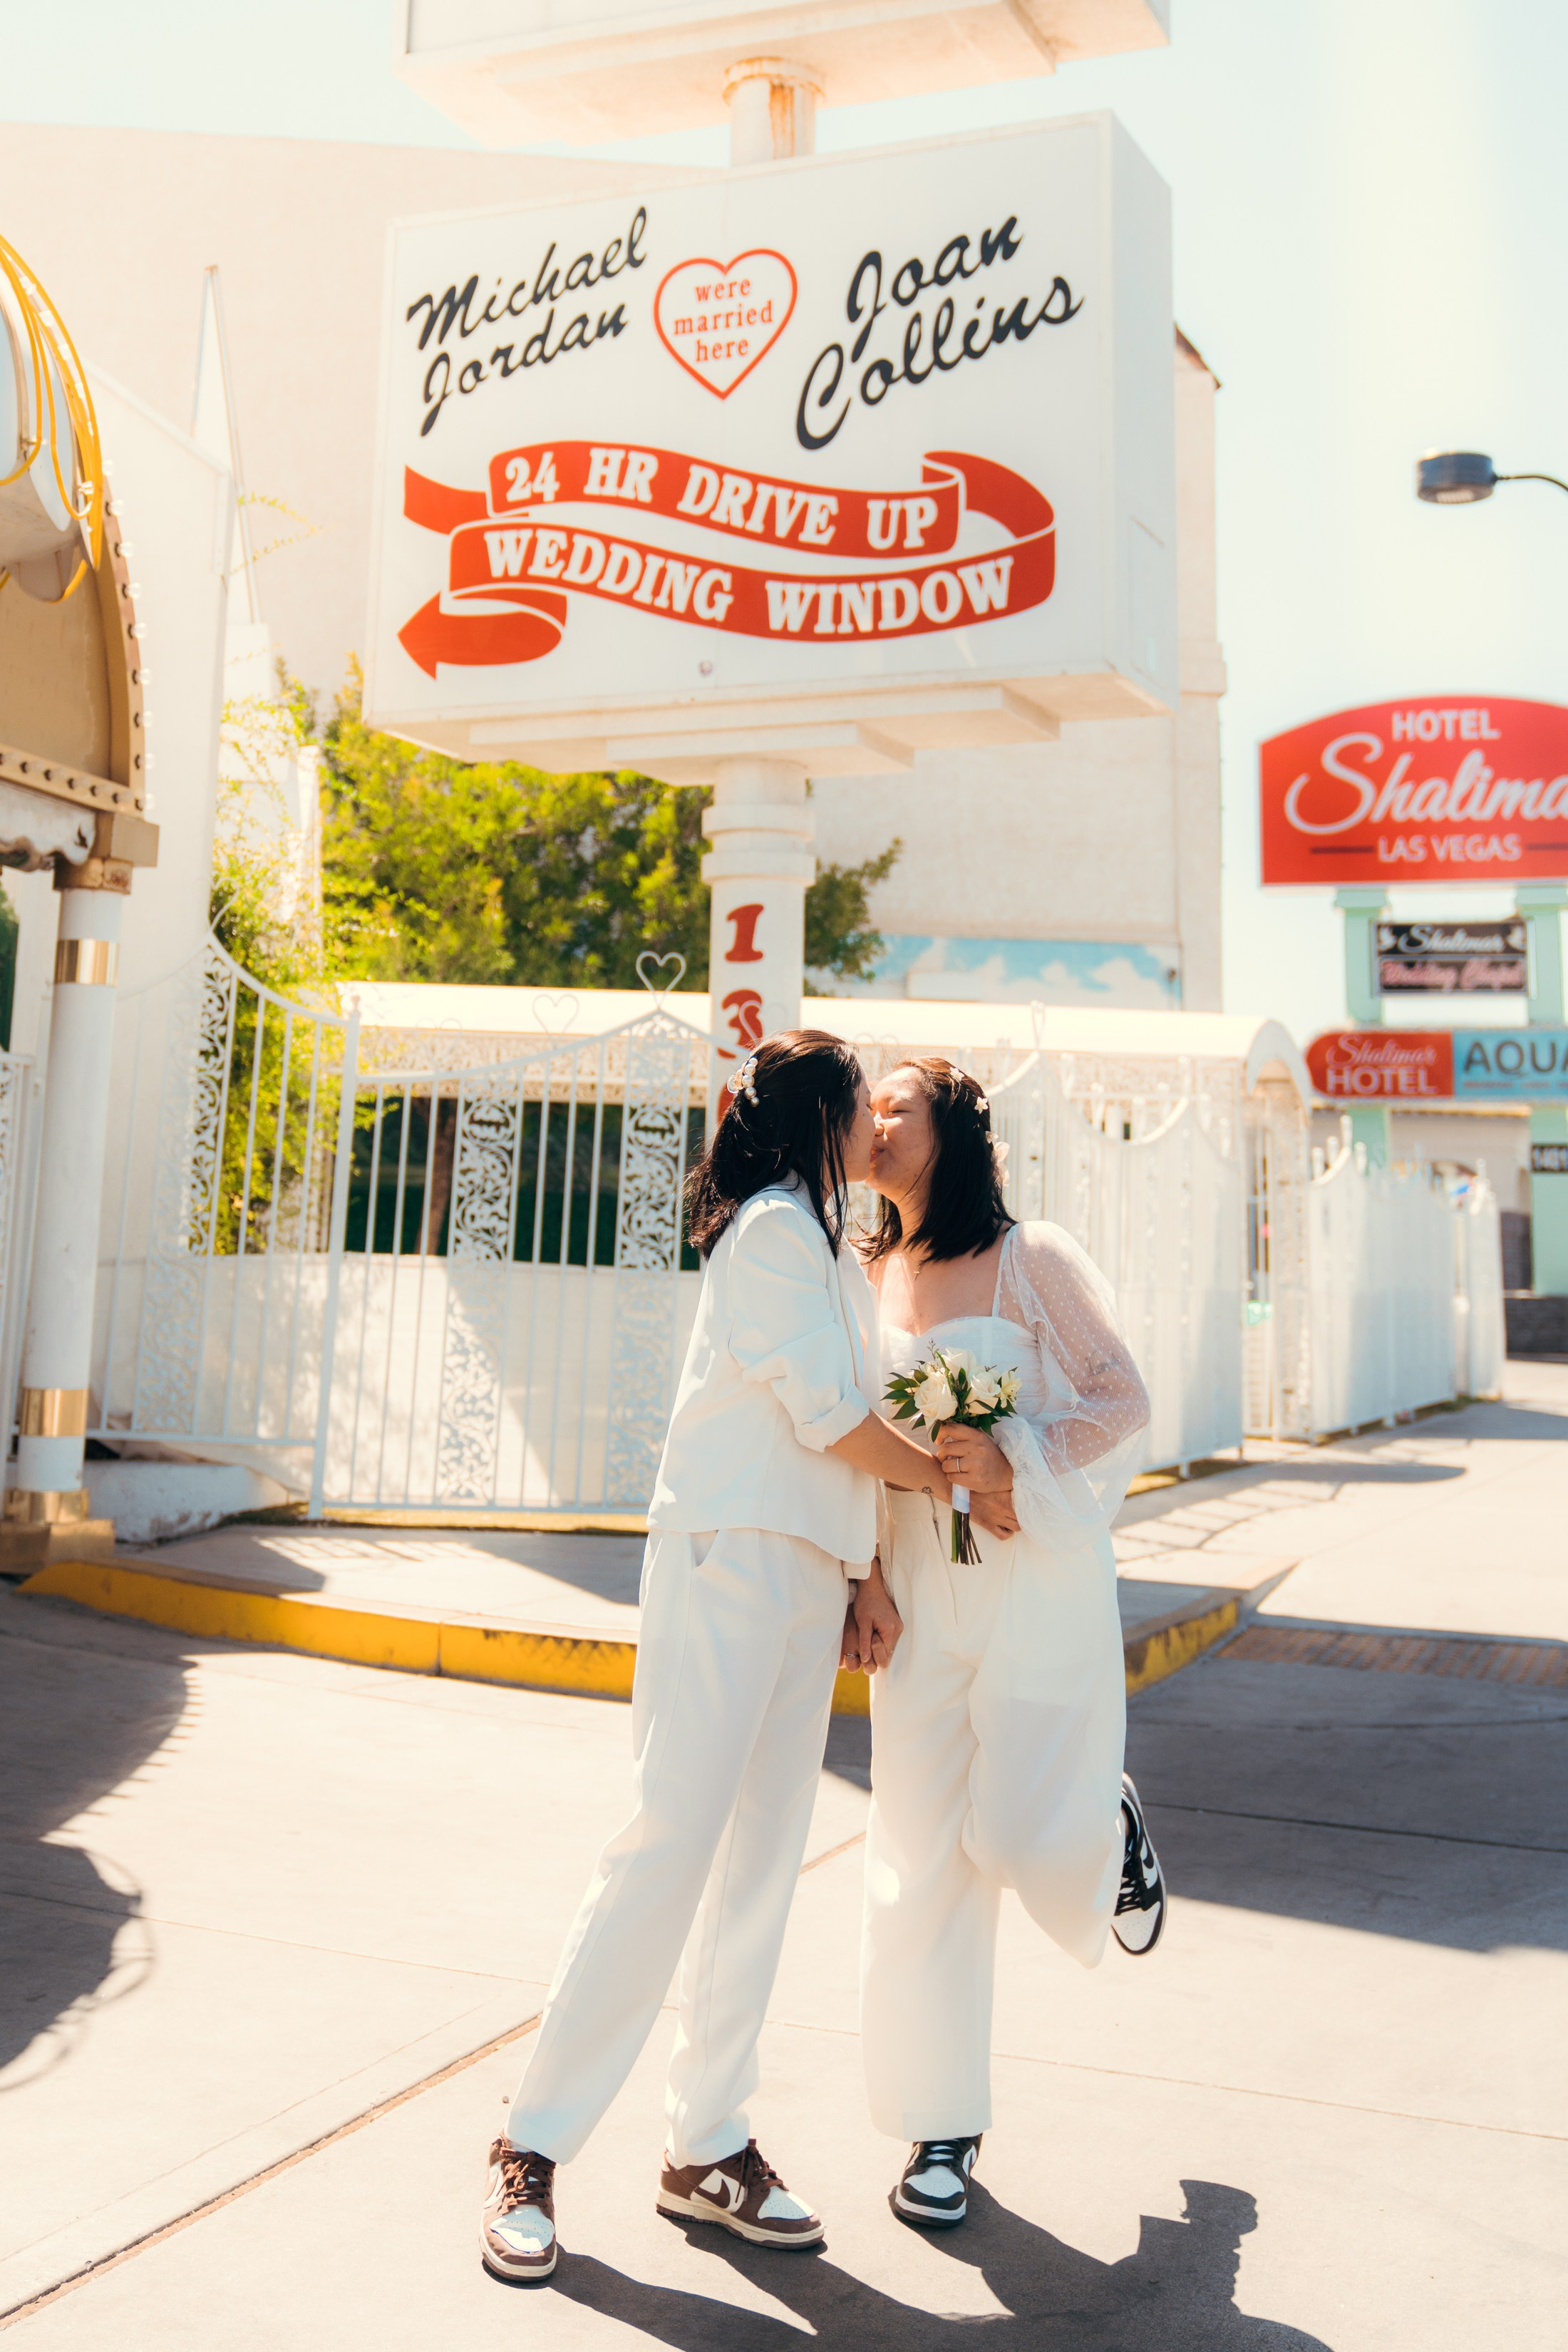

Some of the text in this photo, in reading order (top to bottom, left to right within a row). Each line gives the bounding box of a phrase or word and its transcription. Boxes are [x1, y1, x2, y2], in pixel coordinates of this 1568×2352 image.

[406, 206, 647, 351] Michael
[695, 279, 751, 302] were
[846, 215, 1024, 363] Joan
[674, 299, 773, 335] married
[696, 339, 749, 363] here
[795, 276, 1085, 450] Collins
[421, 306, 629, 437] Jordan
[505, 447, 939, 550] 24 HR DRIVE UP
[483, 528, 1014, 634] WEDDING WINDOW
[1391, 708, 1502, 741] HOTEL
[1378, 835, 1522, 862] LAS VEGAS
[1326, 1034, 1436, 1067] Shalimar
[1327, 1066, 1438, 1095] HOTEL
